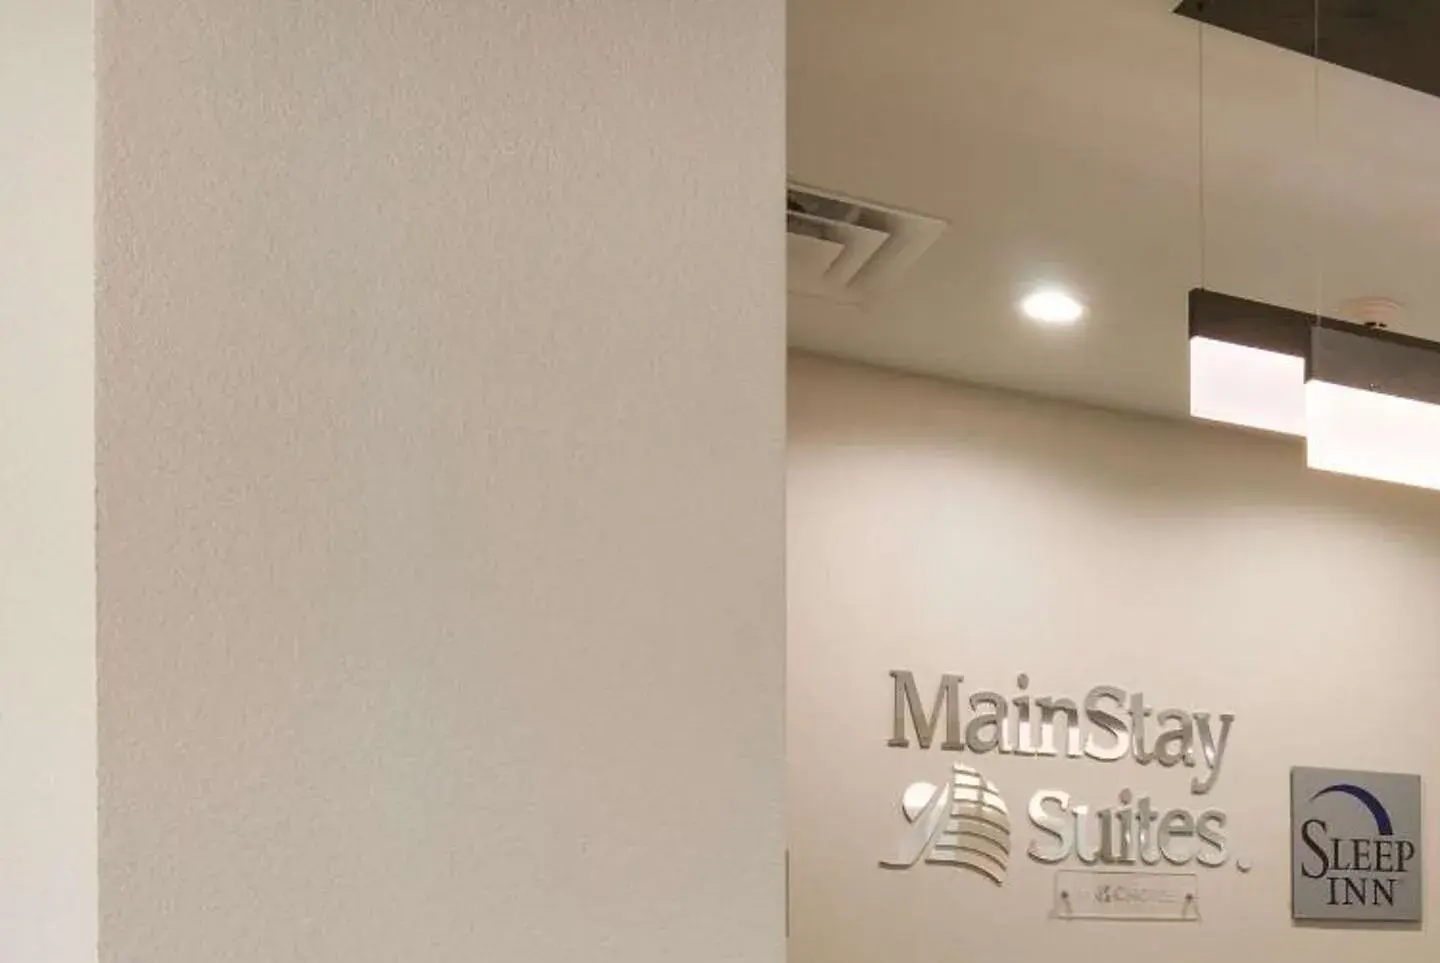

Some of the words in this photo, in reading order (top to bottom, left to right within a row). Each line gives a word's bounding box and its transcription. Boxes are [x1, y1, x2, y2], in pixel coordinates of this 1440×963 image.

[887, 669, 1235, 796] MainStay
[1301, 818, 1416, 878] SLEEP
[1326, 876, 1397, 906] INN
